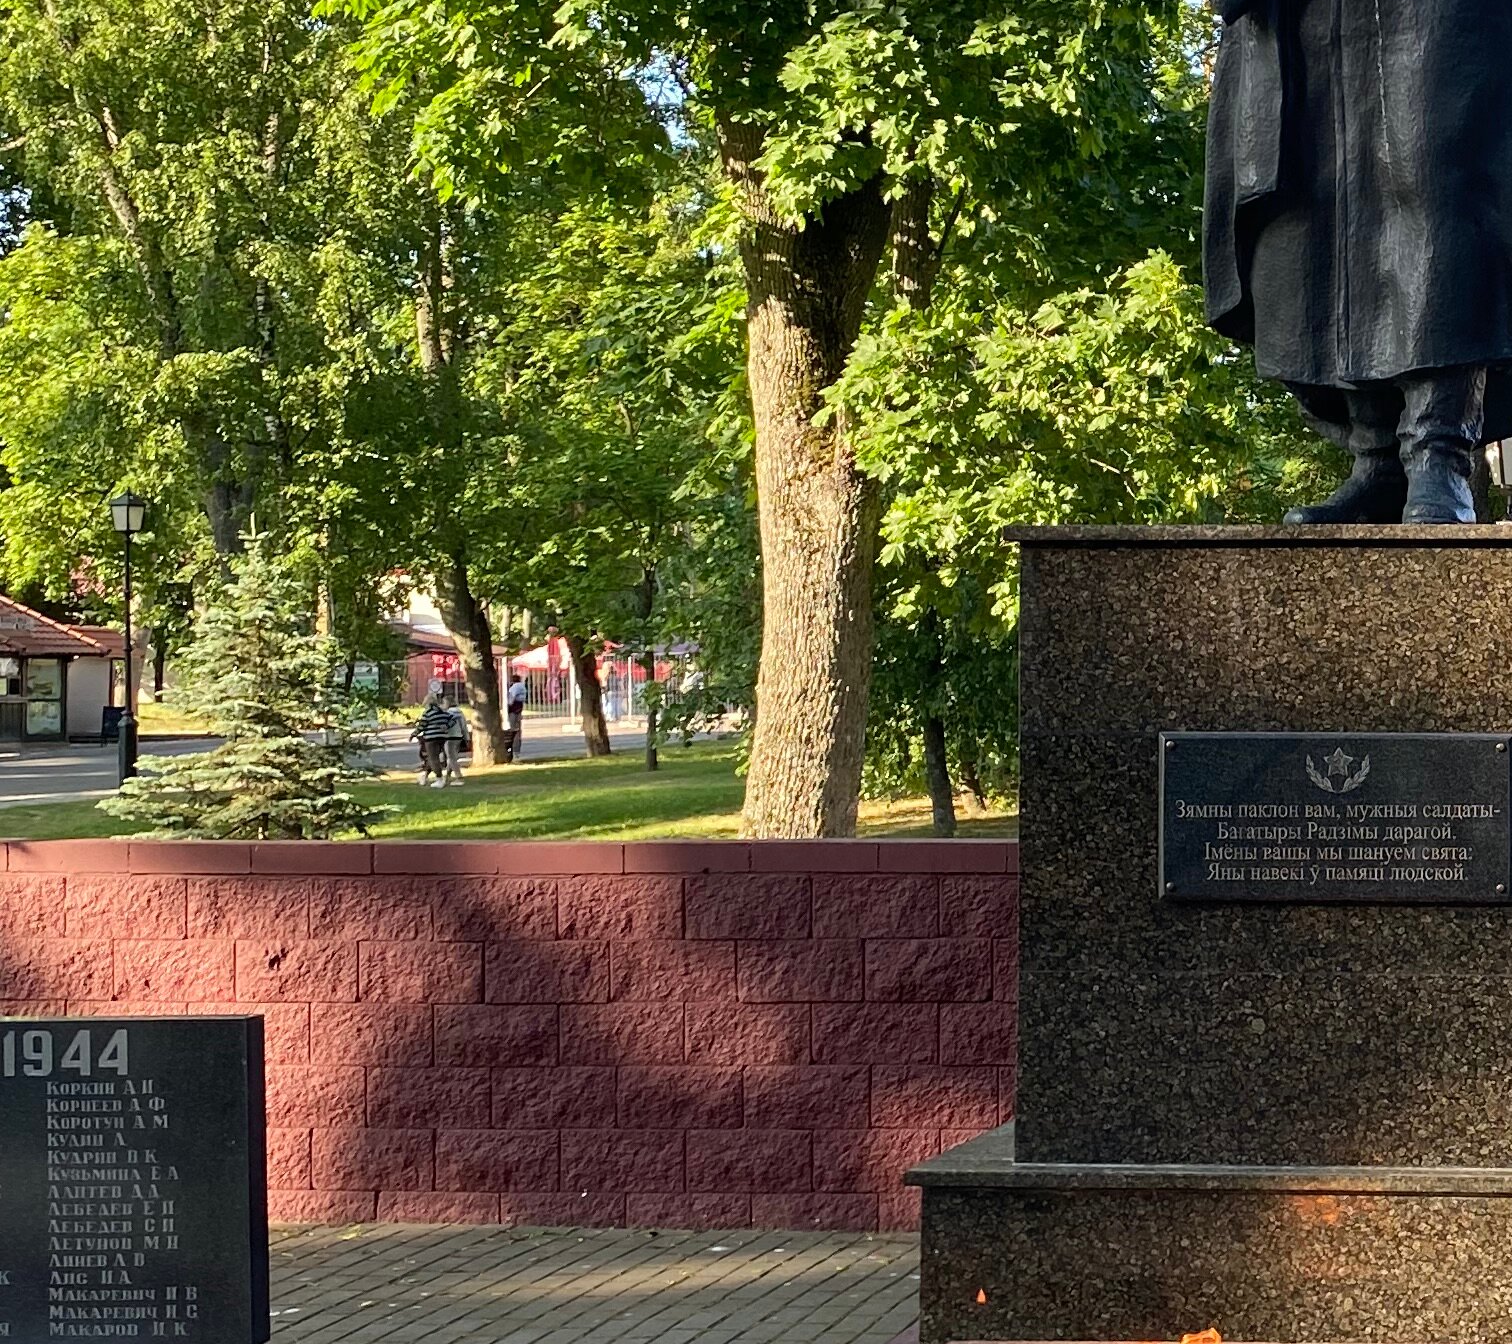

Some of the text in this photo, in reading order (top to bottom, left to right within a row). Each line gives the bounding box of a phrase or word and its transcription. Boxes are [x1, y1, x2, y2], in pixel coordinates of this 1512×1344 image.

[1176, 800, 1500, 822] Зямны паклон вам, мужныя салдаты-
[1218, 822, 1457, 844] Багатыры Радзімы дарагой.
[1205, 842, 1473, 864] Імёны вашы мы шануем свята:
[1207, 862, 1468, 884] Яны навекі ў памяці людской.
[3, 1029, 128, 1077] 1944
[149, 1097, 164, 1111] Ф
[134, 1115, 145, 1128] А
[154, 1115, 167, 1128] М
[145, 1150, 158, 1163] К
[152, 1166, 160, 1180] Е
[168, 1166, 178, 1179] А
[144, 1201, 154, 1215] Е
[145, 1219, 155, 1232] С
[144, 1236, 159, 1249] М
[187, 1305, 197, 1318] С
[175, 1322, 187, 1335] К
